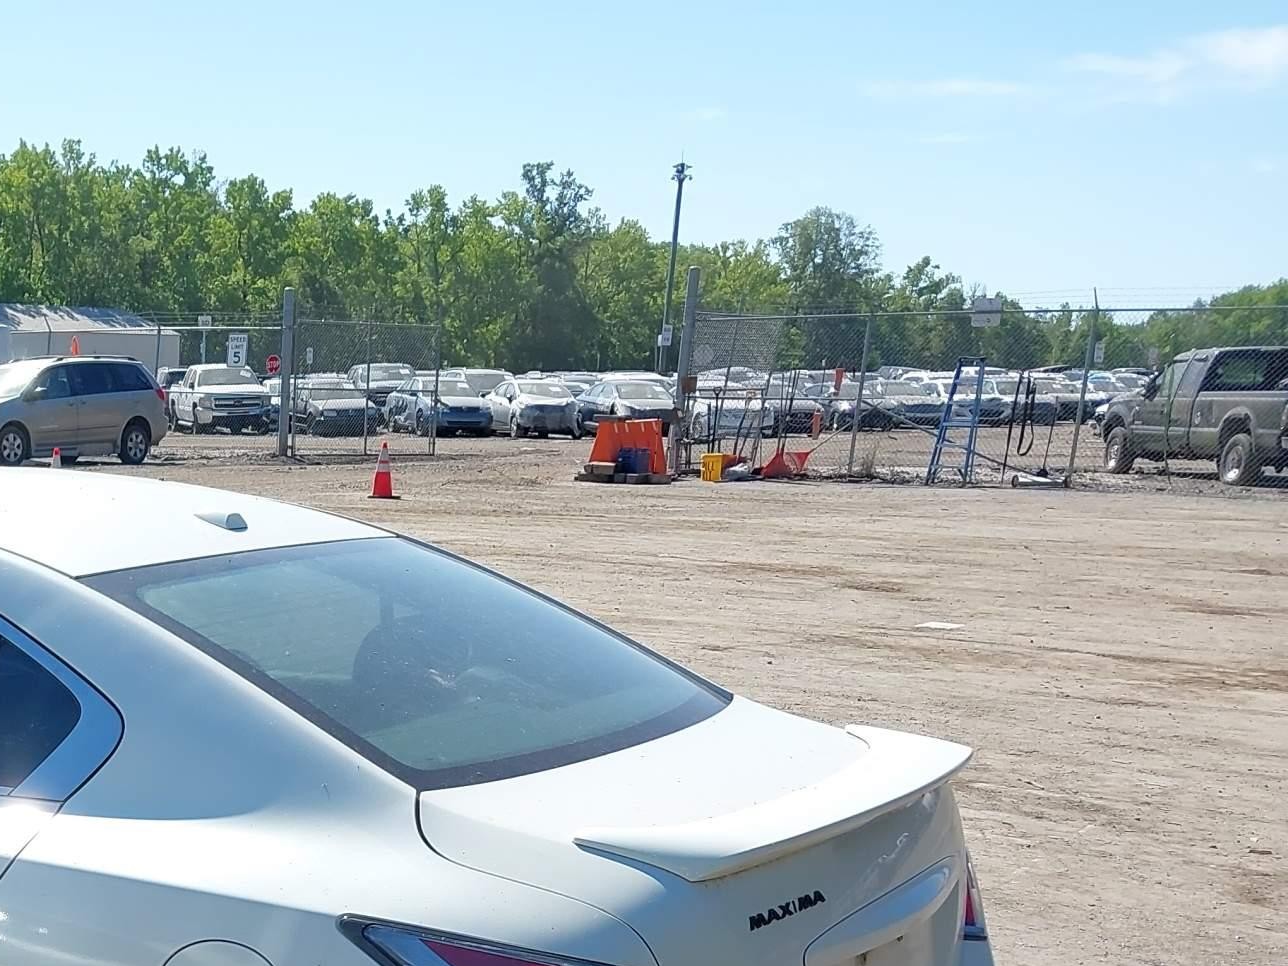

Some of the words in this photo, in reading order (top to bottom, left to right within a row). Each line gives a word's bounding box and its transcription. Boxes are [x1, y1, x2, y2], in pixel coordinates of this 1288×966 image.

[232, 351, 241, 364] 5
[267, 360, 280, 369] STOP
[748, 890, 827, 932] MAXIMA
